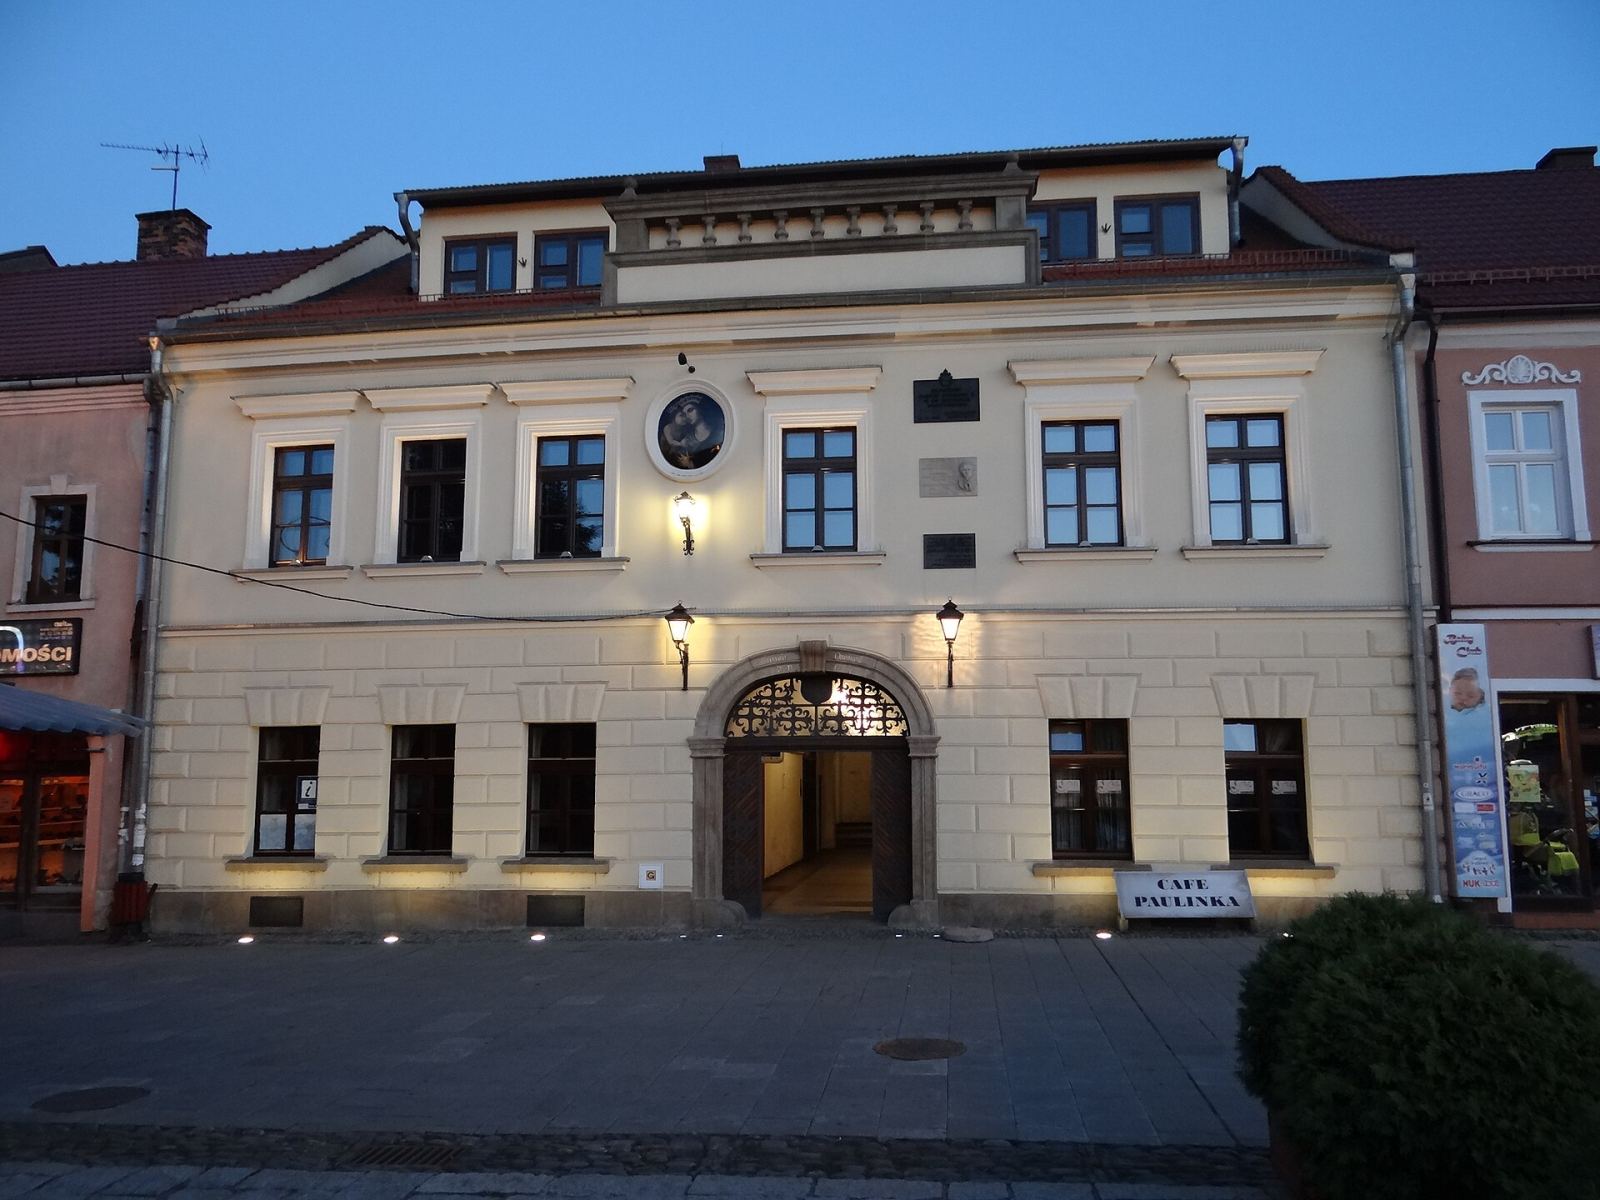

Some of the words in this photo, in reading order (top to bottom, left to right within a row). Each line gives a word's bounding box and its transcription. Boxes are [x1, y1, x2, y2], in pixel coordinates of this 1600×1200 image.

[0, 643, 73, 663] MOŚCI
[1157, 879, 1209, 890] CAFE
[1134, 896, 1241, 907] PAULINKA
